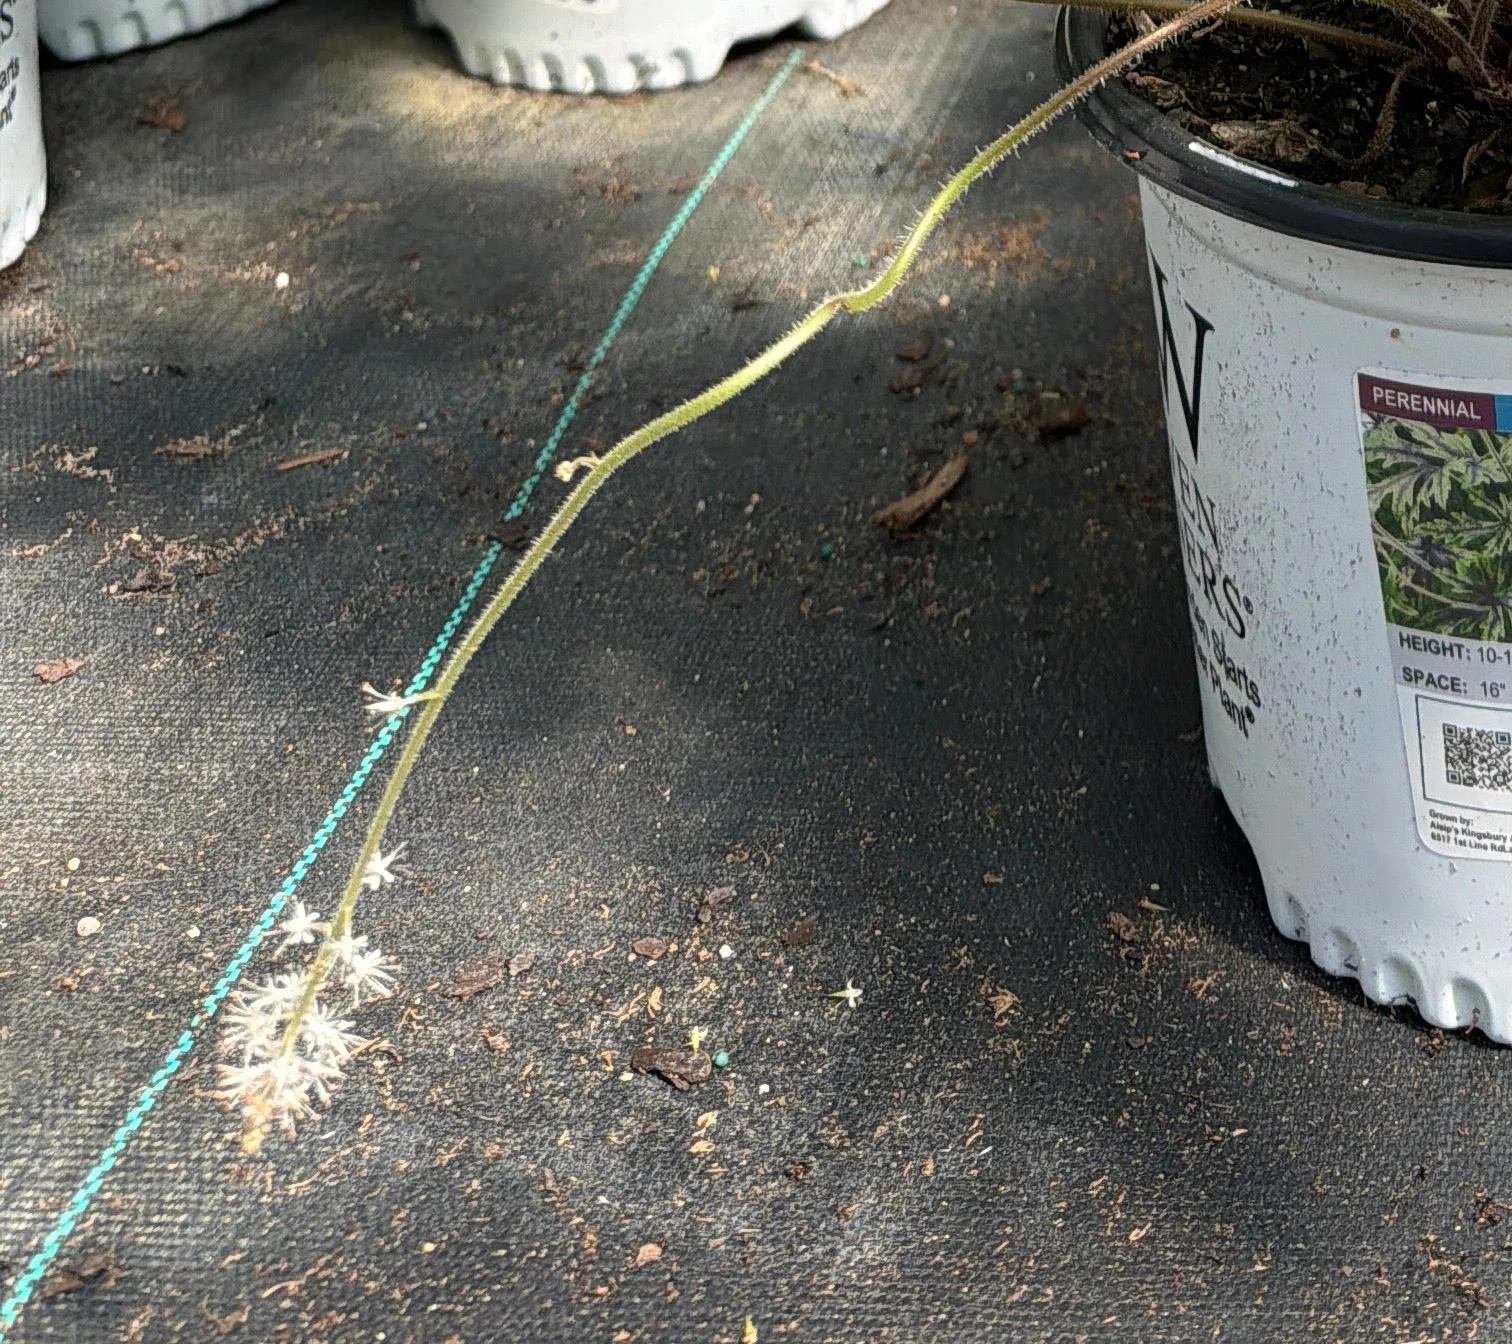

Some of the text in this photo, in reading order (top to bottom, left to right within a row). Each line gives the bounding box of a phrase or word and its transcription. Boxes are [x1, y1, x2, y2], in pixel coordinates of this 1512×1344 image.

[1372, 385, 1482, 421] PERENNIAL
[1399, 630, 1471, 662] HEIGHT:
[1211, 628, 1262, 709] Starts
[1401, 666, 1468, 694] SPACE:
[1480, 681, 1506, 698] 16"
[1428, 808, 1474, 827] Grown by:
[1430, 821, 1460, 836] Alsip's
[1461, 825, 1509, 843] Kingsbury
[1454, 837, 1468, 847] 1st
[1469, 839, 1489, 851] Line
